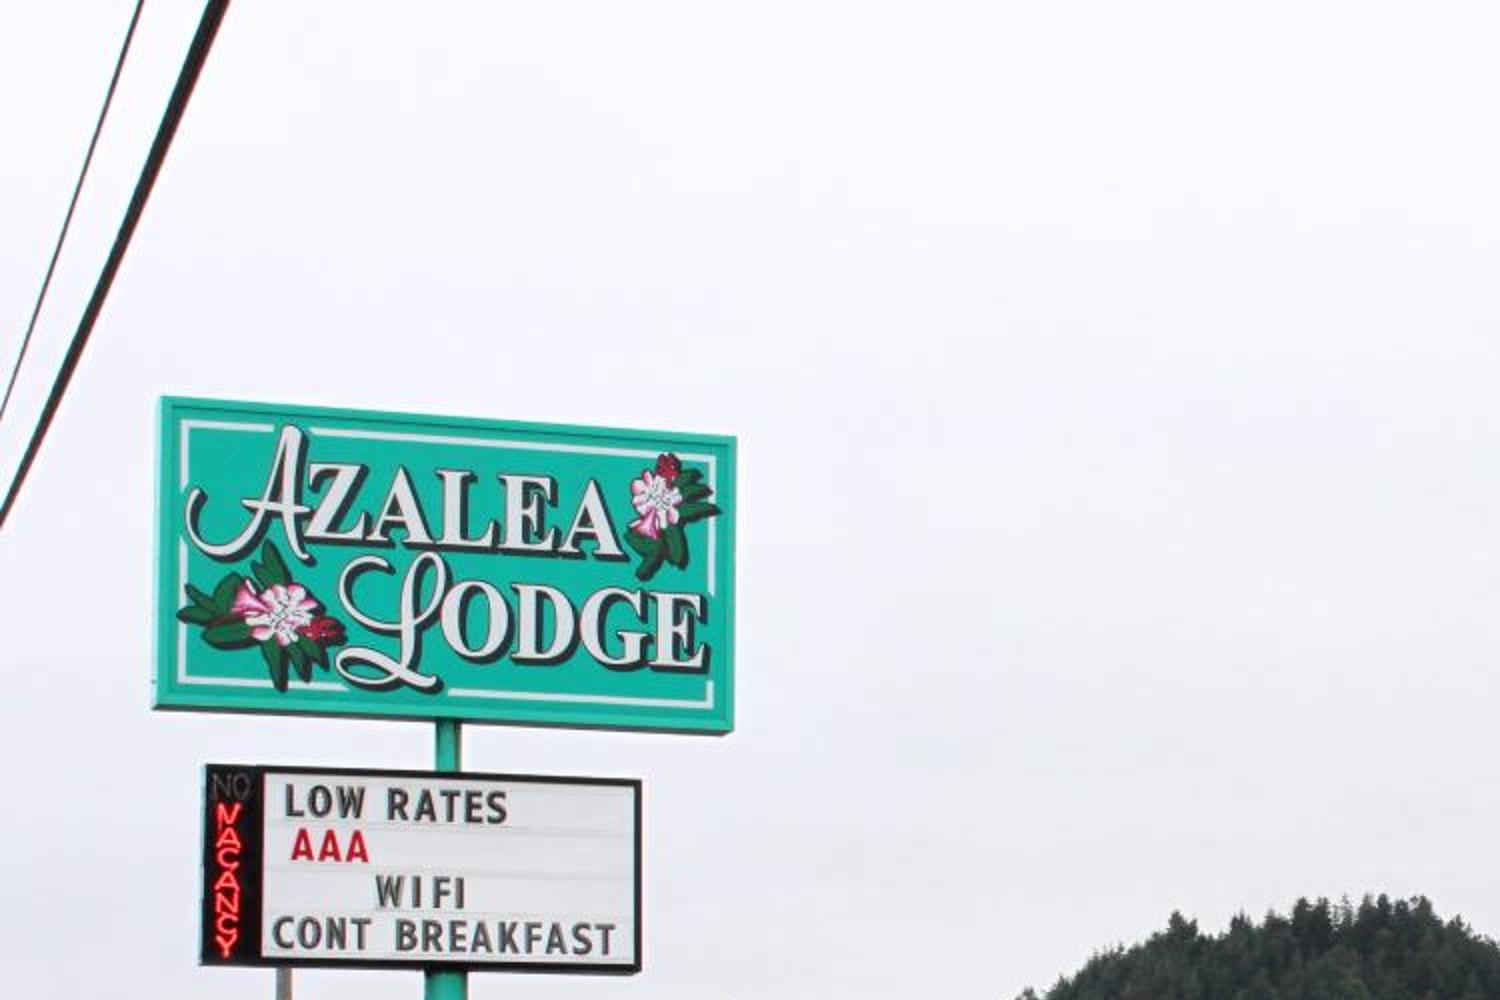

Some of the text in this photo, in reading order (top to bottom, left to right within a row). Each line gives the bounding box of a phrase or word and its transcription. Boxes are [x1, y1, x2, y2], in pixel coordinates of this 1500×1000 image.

[186, 424, 628, 564] AZALEA
[336, 551, 708, 690] LODGE
[213, 772, 250, 799] NO
[285, 784, 508, 824] LOW RATES
[291, 828, 370, 864] AAA
[215, 802, 241, 958] VACANCY
[375, 875, 466, 910] WIFI
[272, 916, 617, 956] CONT BREAKFAST
